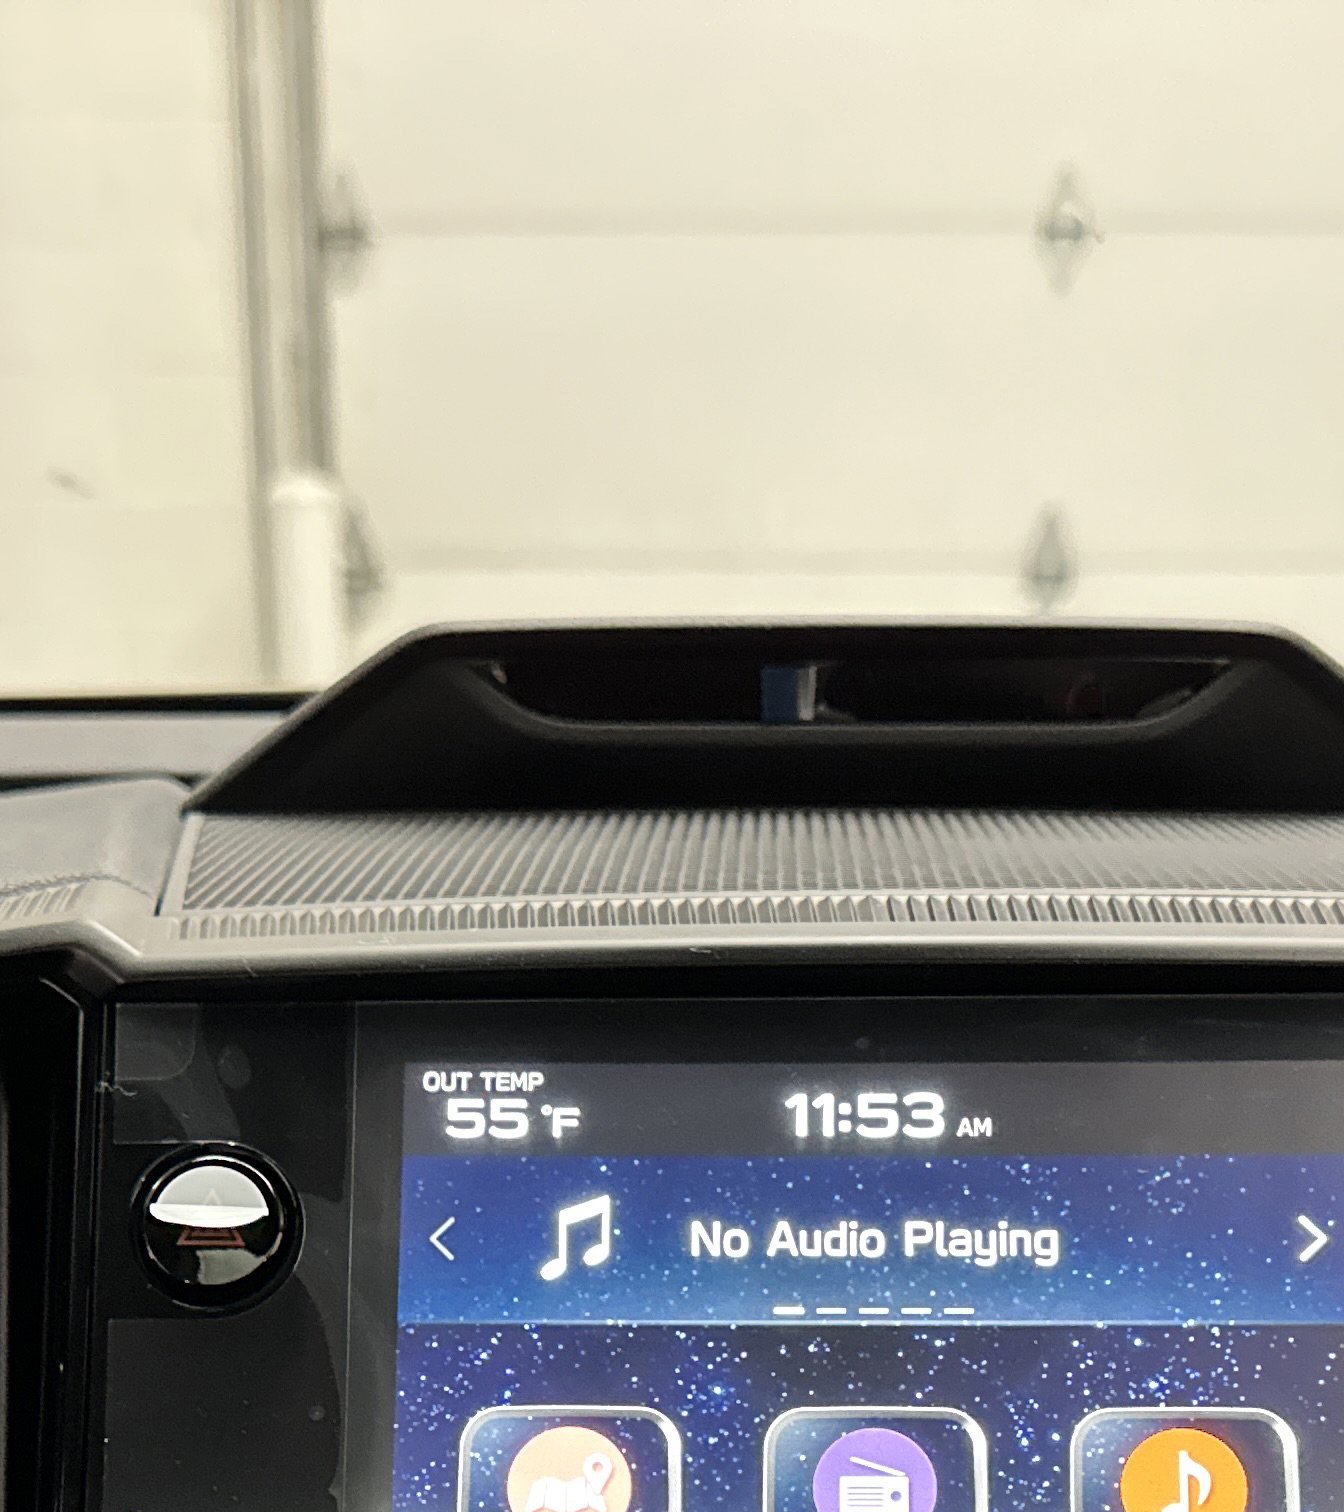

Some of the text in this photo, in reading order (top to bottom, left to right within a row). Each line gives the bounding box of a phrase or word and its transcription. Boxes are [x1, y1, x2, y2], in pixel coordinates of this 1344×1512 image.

[422, 1071, 545, 1092] OUT TEMP
[445, 1098, 530, 1139] 55
[784, 1091, 994, 1140] 11:53 AM
[689, 1219, 1060, 1268] No Audio Playing
